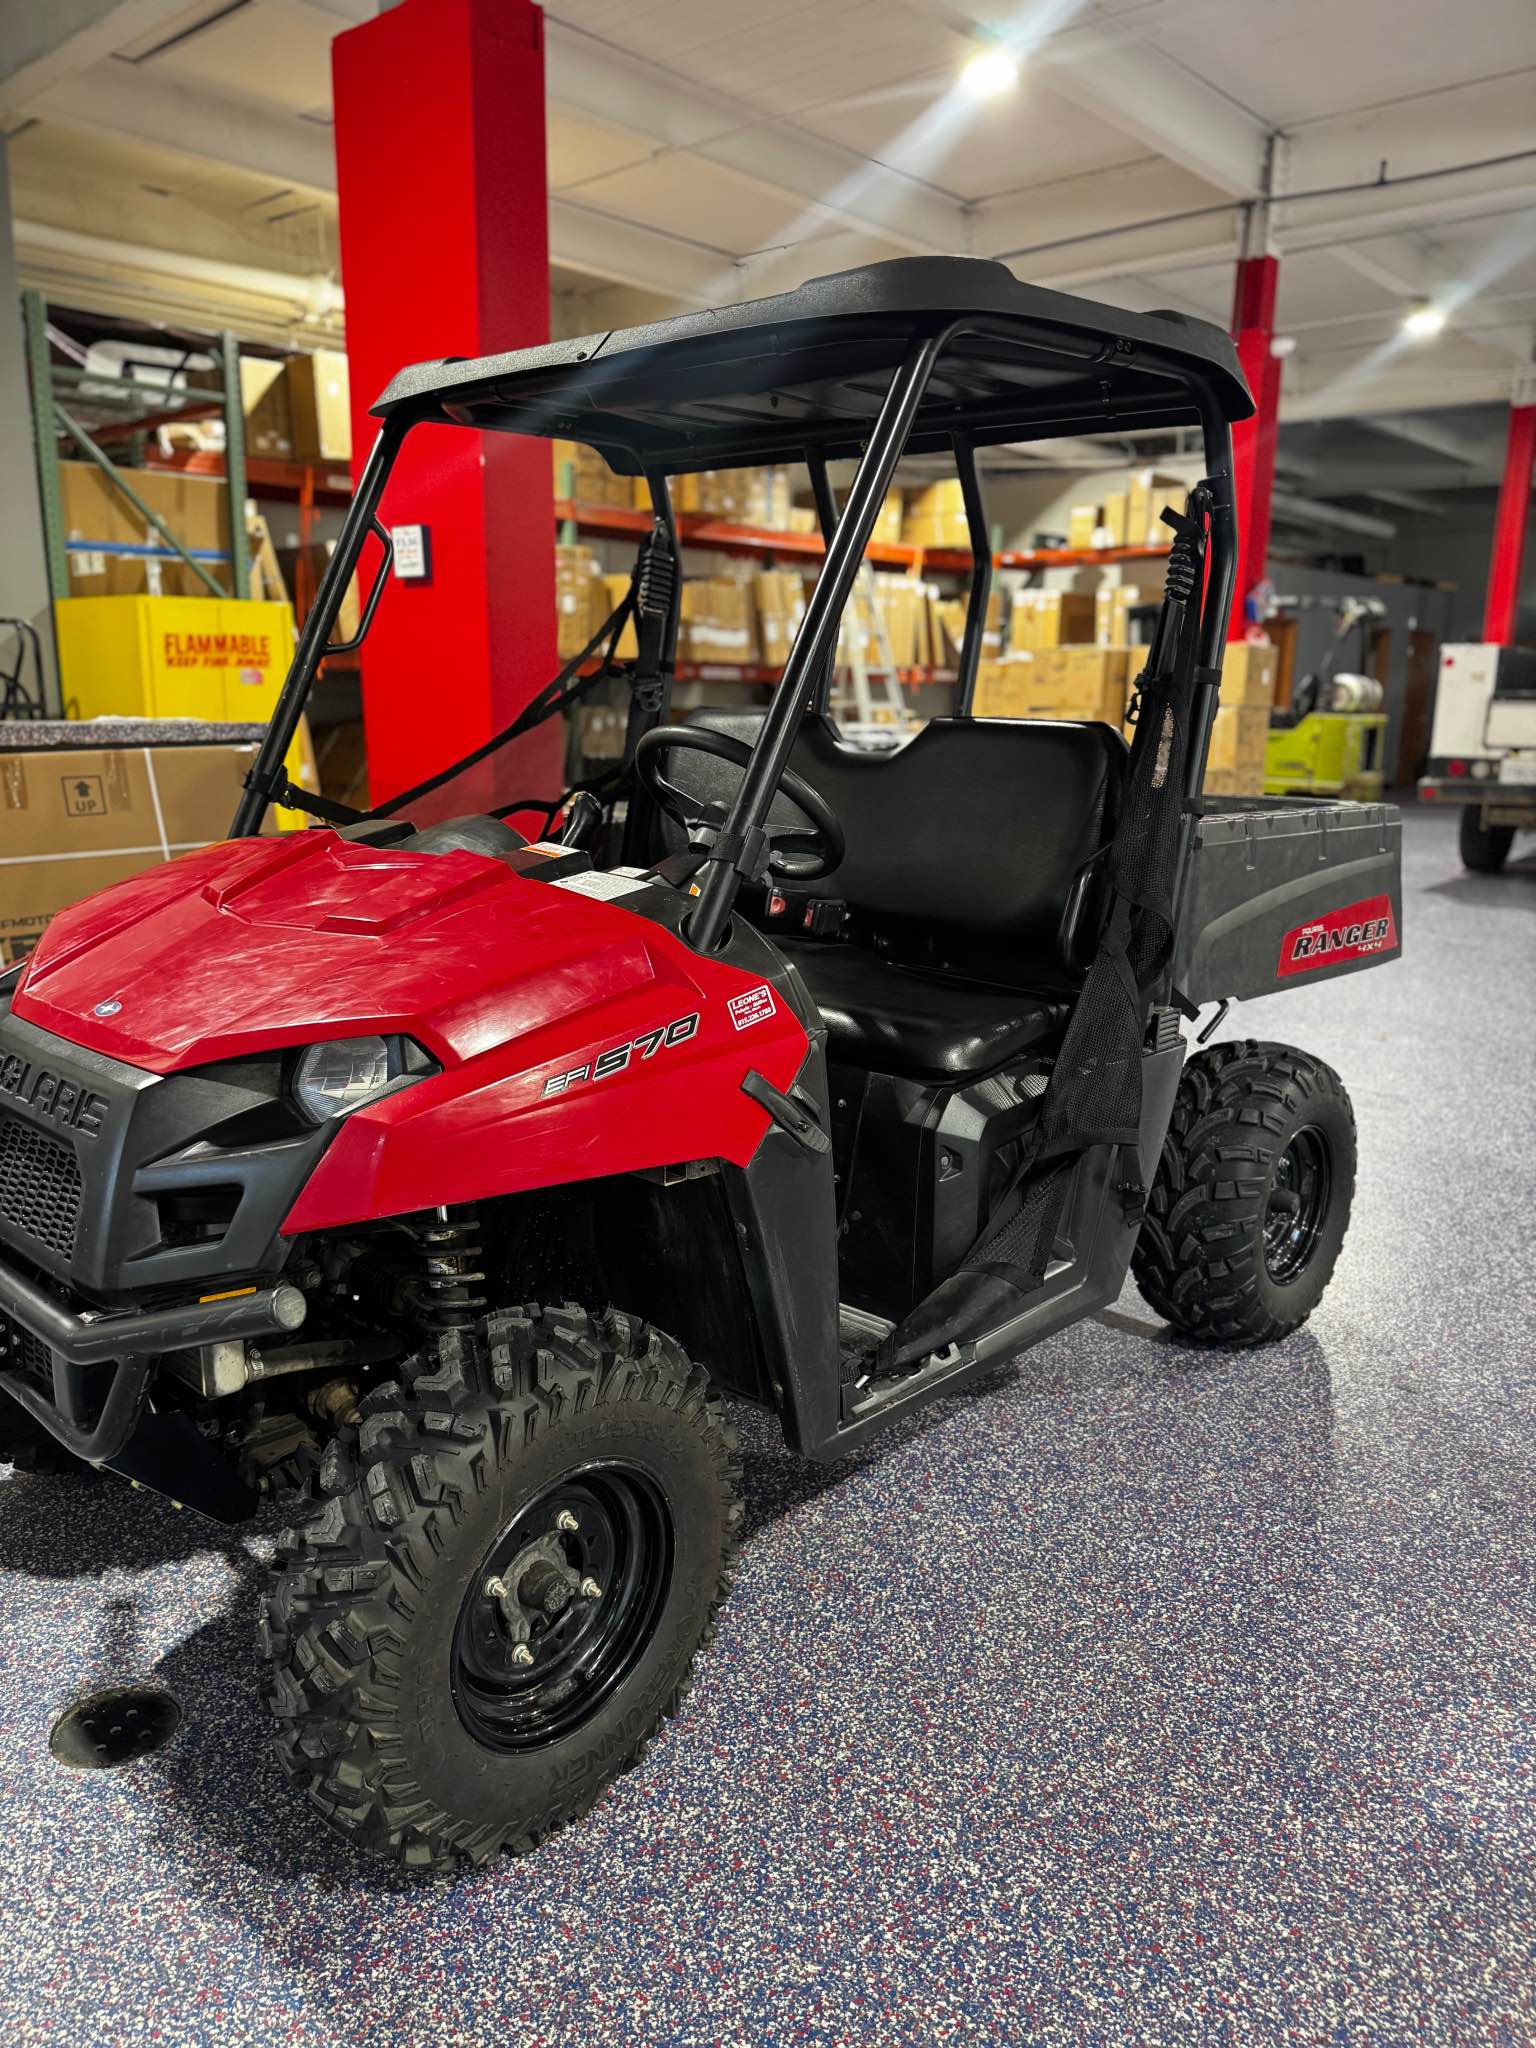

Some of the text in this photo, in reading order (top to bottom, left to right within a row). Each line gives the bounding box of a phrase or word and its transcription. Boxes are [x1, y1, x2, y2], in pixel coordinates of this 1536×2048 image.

[164, 632, 270, 656] FLAMMABLE
[166, 656, 198, 668] KEEP
[75, 799, 97, 812] UP
[1291, 917, 1390, 961] RANGER
[732, 990, 767, 1010] LEONE'S
[541, 1012, 700, 1100] EFI 570
[0, 1052, 110, 1138] OLARIS
